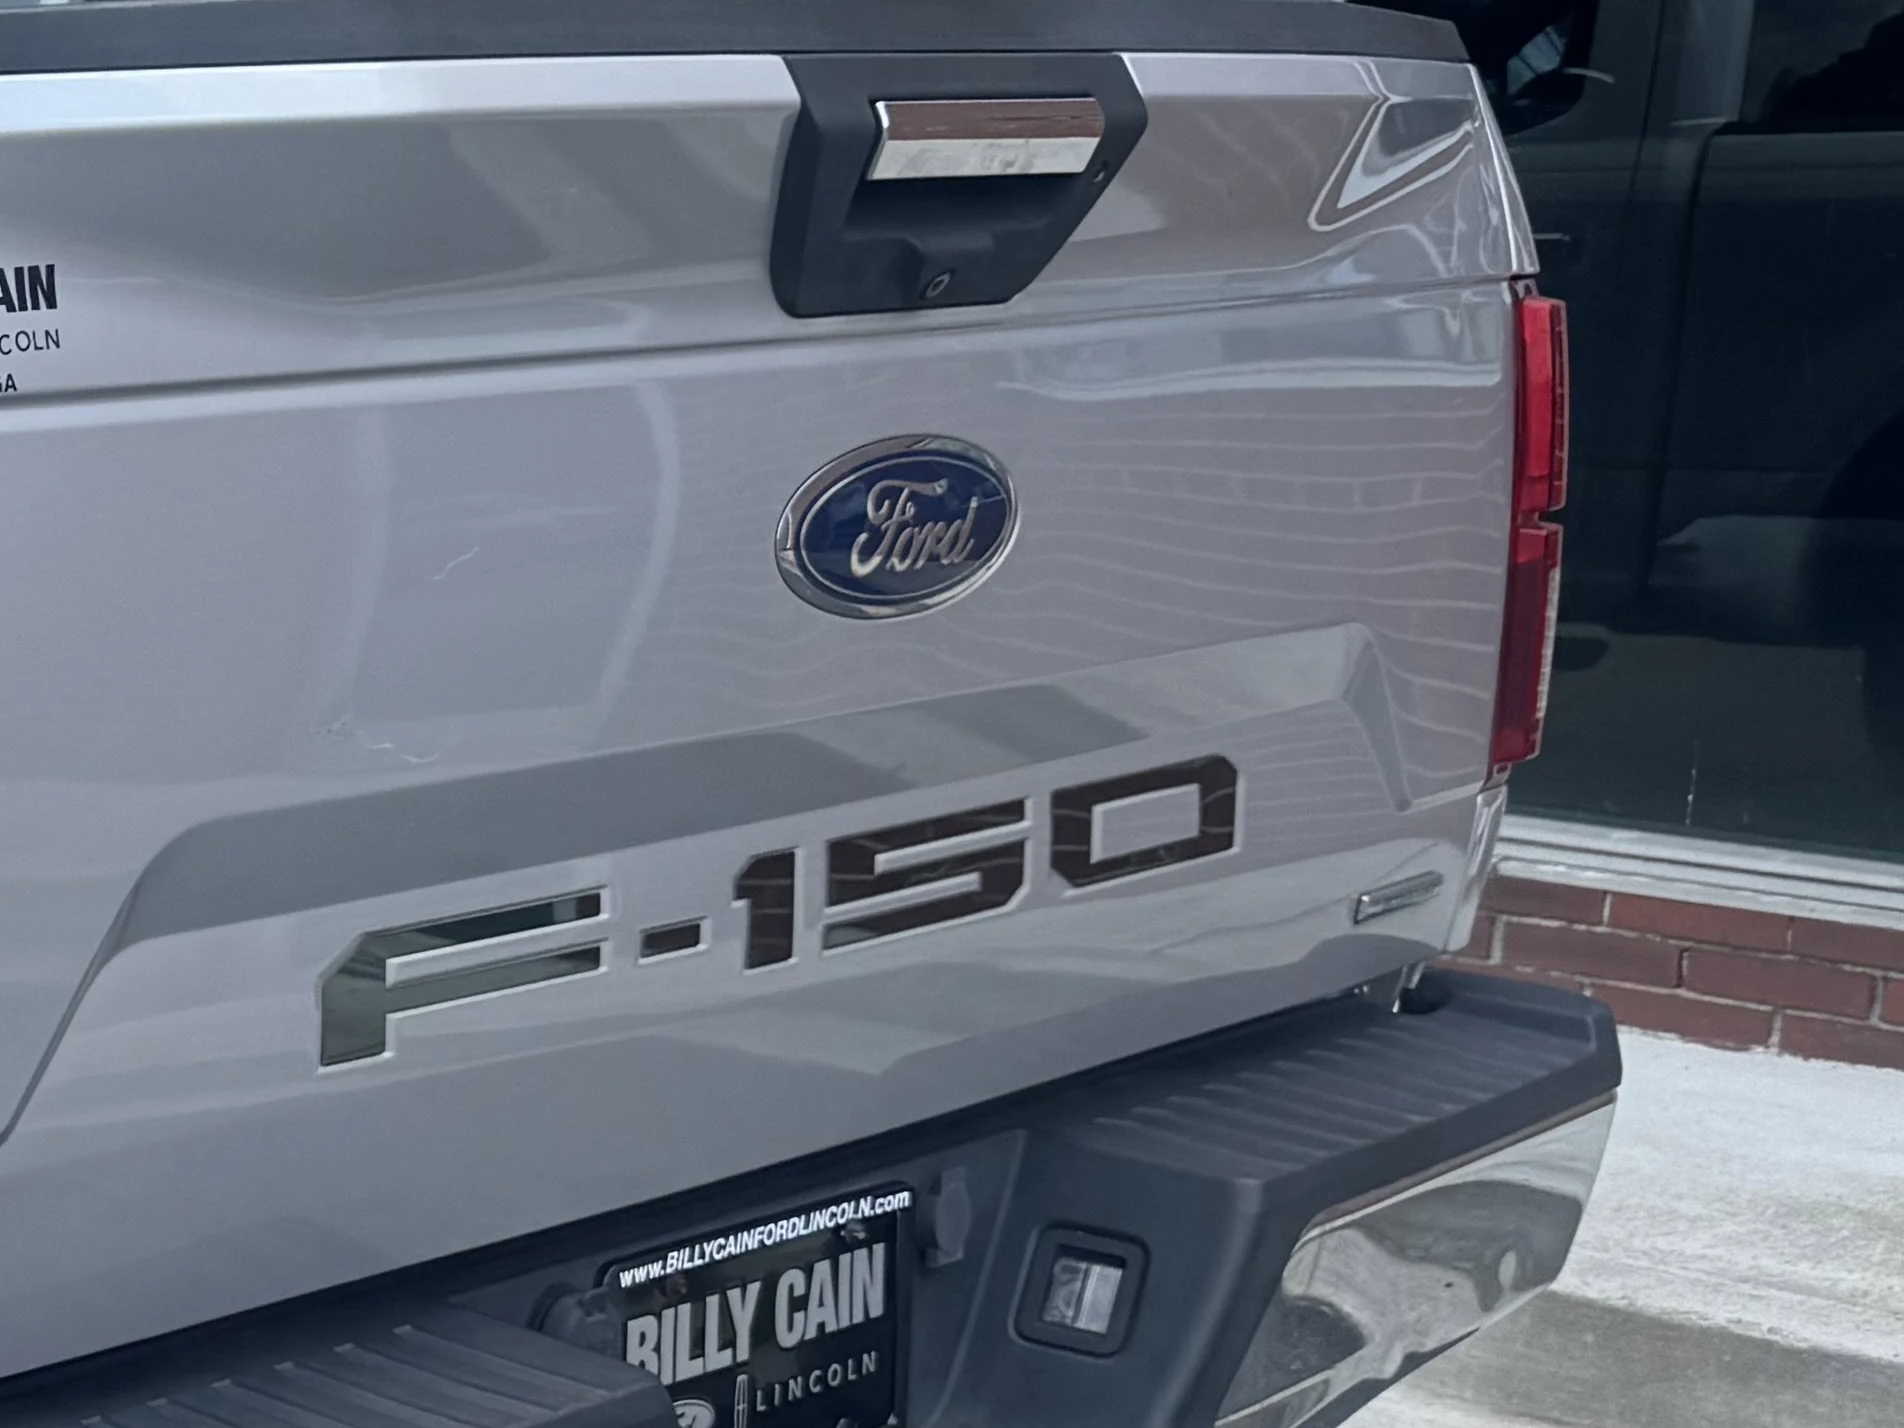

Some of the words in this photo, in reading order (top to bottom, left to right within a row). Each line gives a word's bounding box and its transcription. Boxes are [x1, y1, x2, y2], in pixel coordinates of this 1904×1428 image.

[851, 478, 978, 578] Ford
[315, 752, 1242, 1072] F-150
[619, 1189, 912, 1288] www.BILLYCAINFORDLINCOLN.com
[626, 1280, 761, 1386] BILLY
[775, 1242, 886, 1350] CAIN
[755, 1350, 879, 1414] LINCOLN
